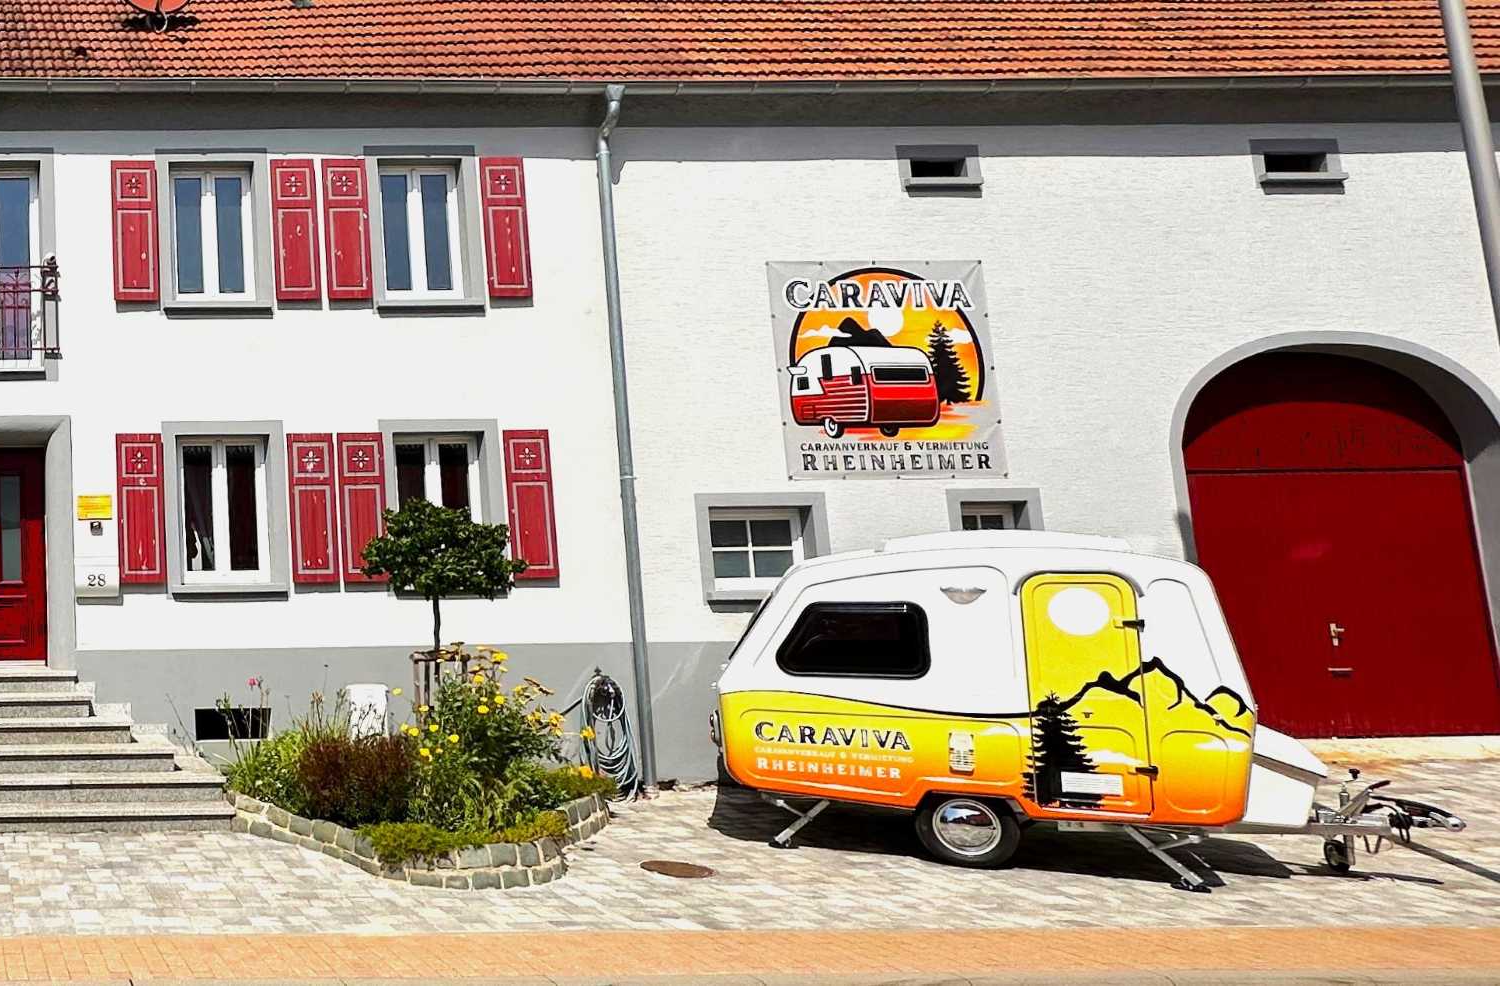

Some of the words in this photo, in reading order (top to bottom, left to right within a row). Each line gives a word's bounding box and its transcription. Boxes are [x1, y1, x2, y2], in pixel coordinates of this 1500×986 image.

[786, 280, 972, 309] CARAVIVA
[800, 442, 899, 451] CARAVANVERKAUF
[904, 442, 911, 450] &
[916, 441, 989, 450] VERMIETUNG
[802, 453, 992, 471] RHEINHEIMER
[88, 574, 106, 587] 28
[755, 721, 911, 750] CARAVIVA
[757, 758, 901, 778] RHEINHEIMER
